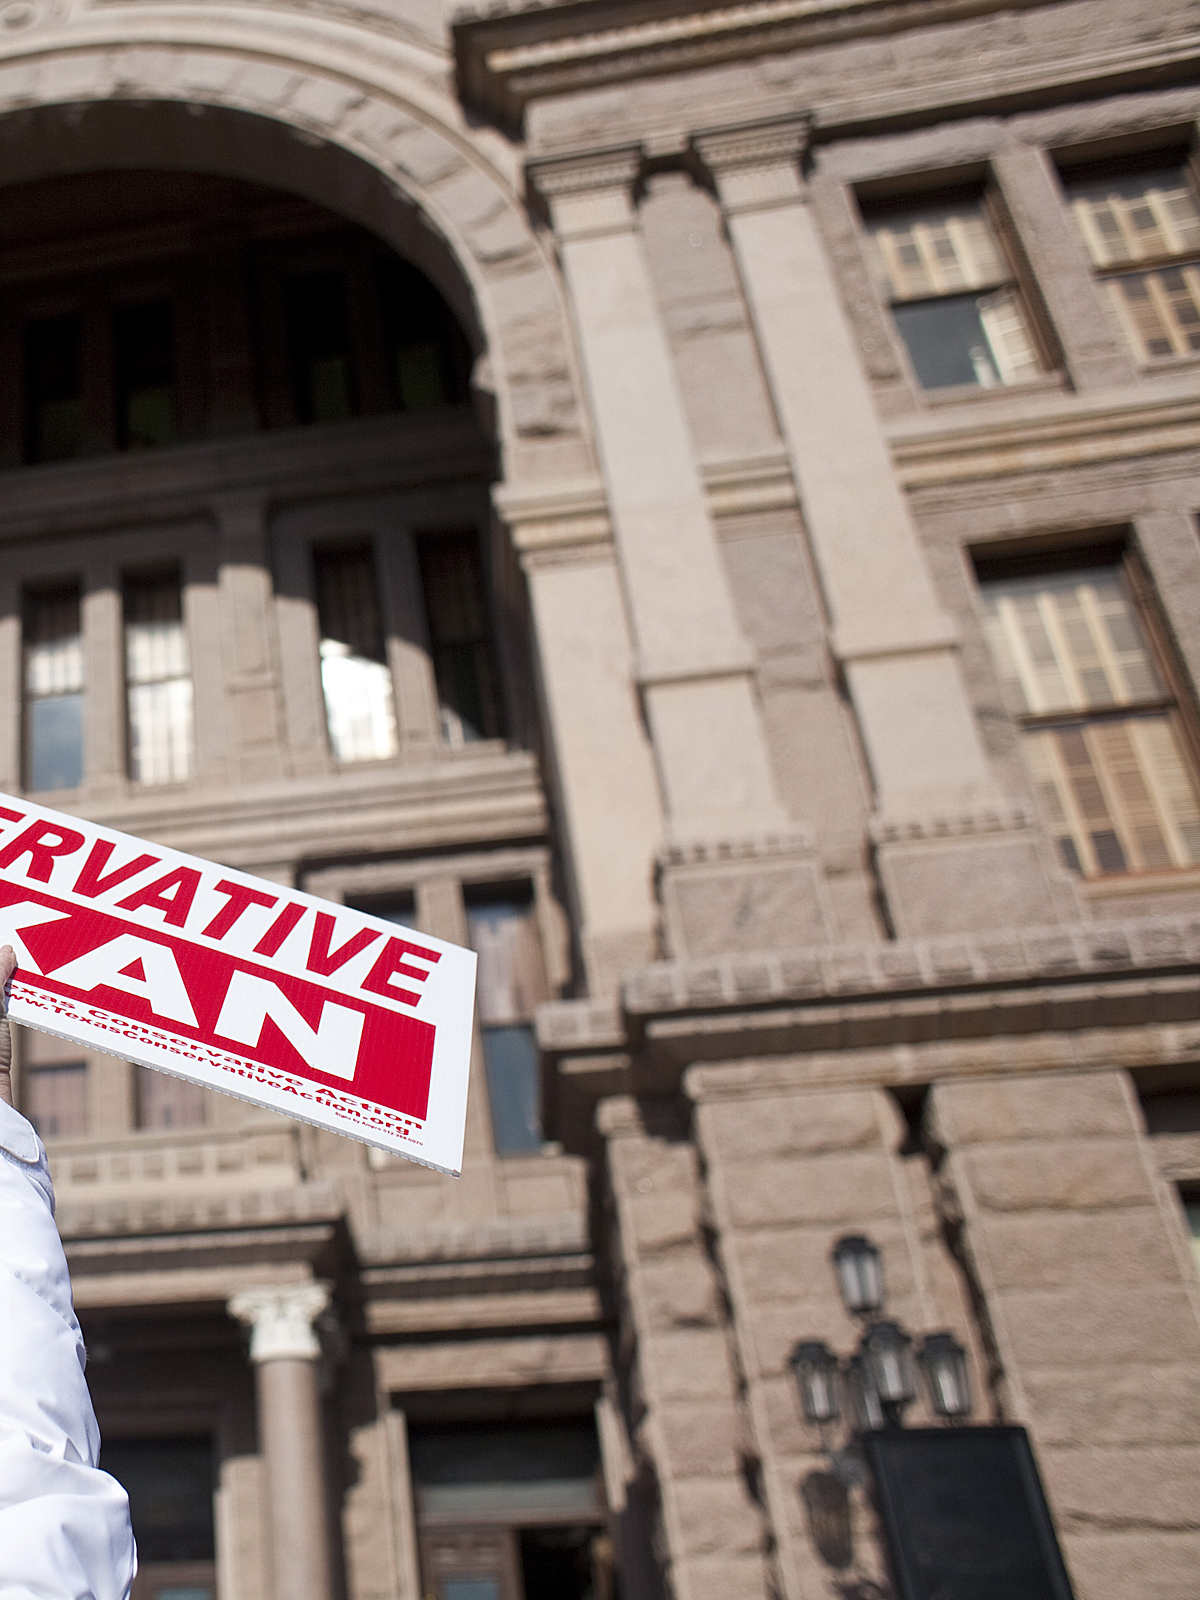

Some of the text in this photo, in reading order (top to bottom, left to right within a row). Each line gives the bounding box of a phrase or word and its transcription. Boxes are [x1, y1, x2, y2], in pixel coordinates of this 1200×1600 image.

[4, 982, 423, 1130] exas Conservative Action
[4, 990, 410, 1136] ww.TexasConservativeAction.org
